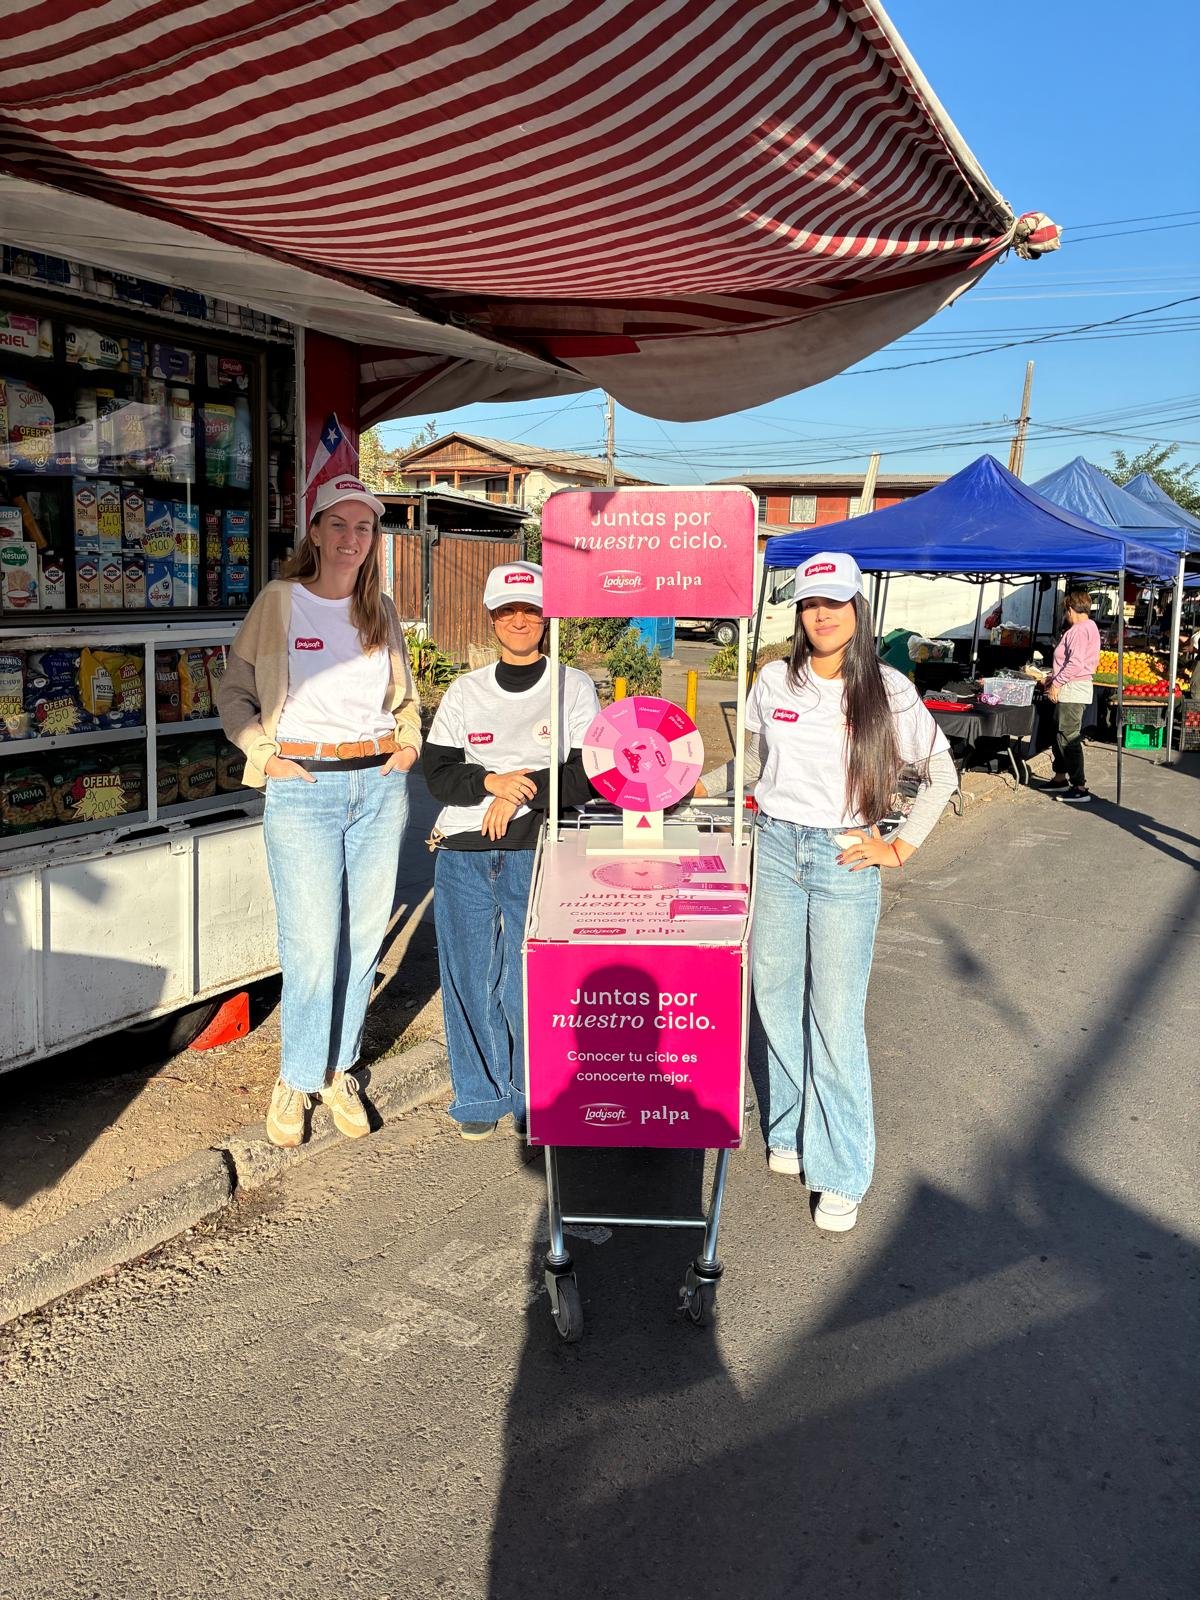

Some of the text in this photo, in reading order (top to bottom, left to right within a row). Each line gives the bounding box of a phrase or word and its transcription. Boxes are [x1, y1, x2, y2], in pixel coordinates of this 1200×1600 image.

[0, 334, 28, 347] RIEL
[98, 504, 121, 513] OFERT
[592, 510, 711, 531] Juntas por
[574, 531, 728, 550] nuestro ciclo.
[1, 552, 28, 561] Nestum
[603, 574, 642, 588] Ladysoft
[656, 571, 702, 591] palpa
[43, 698, 74, 711] OFERTA
[83, 775, 121, 788] OFERTA
[158, 777, 177, 787] ARMA
[191, 771, 214, 784] PARMA
[121, 781, 141, 789] ARMA
[11, 789, 44, 803] PARMA
[92, 798, 117, 814] 2000
[636, 927, 686, 935] palpa
[570, 988, 698, 1011] Juntas por
[552, 1012, 716, 1030] nuestro ciclo.
[567, 1050, 697, 1063] Conocer tu ciclo es
[576, 1071, 692, 1086] conocerte mejor.
[584, 1107, 627, 1122] Ladysoft
[640, 1105, 690, 1125] palpa
